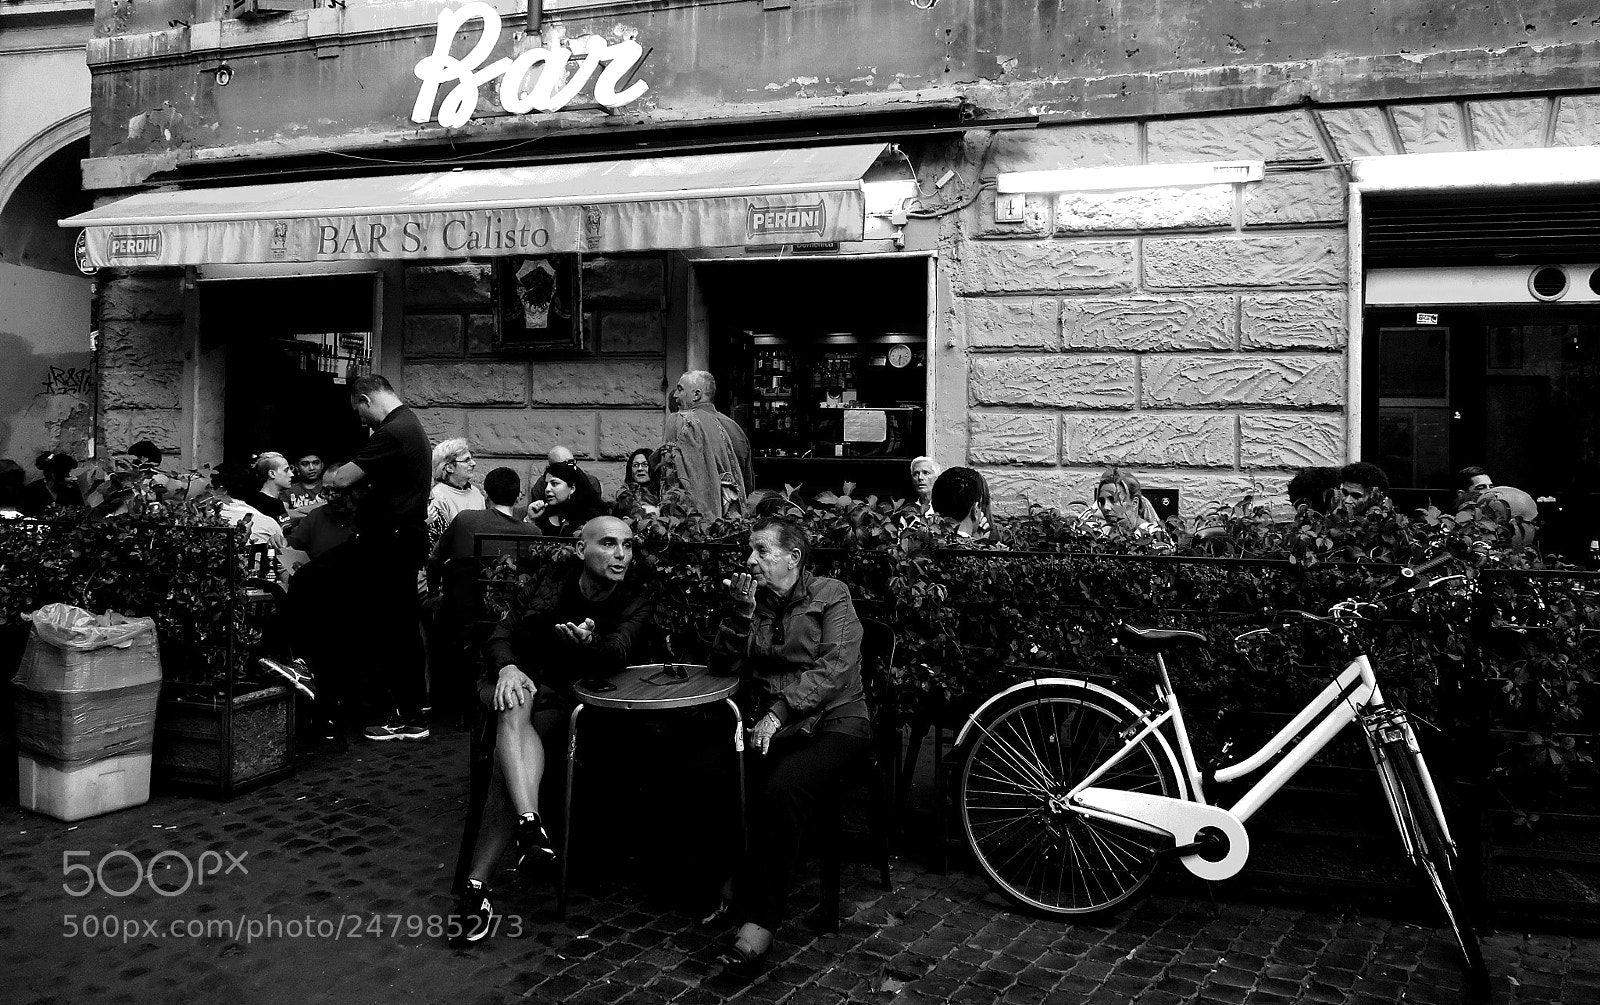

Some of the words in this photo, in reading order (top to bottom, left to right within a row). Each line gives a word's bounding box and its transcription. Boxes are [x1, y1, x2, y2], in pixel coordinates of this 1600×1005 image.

[411, 1, 650, 128] Bar
[317, 223, 391, 255] BAR
[401, 221, 428, 253] S.
[442, 215, 549, 251] Calisto
[753, 210, 820, 230] PERONI
[112, 238, 157, 254] PERONI
